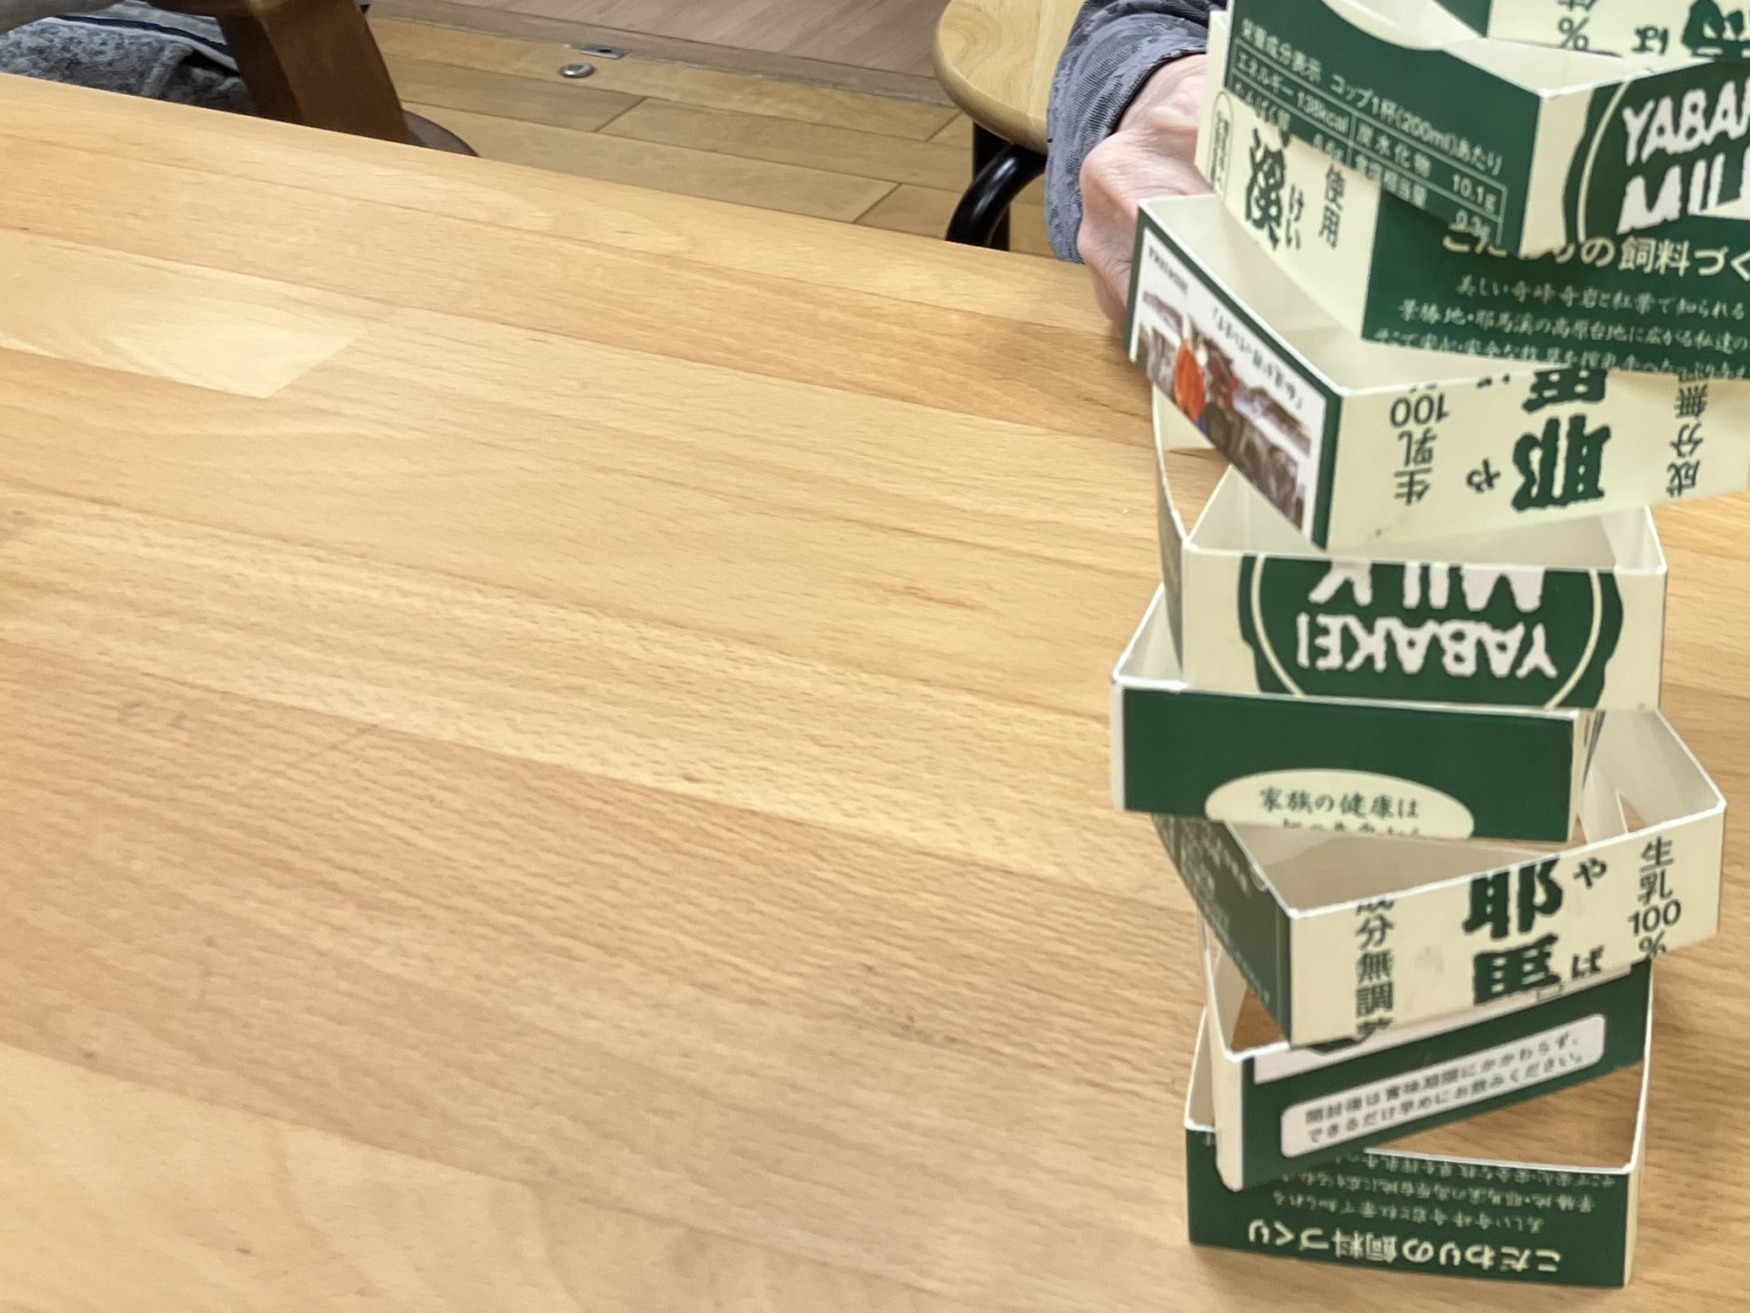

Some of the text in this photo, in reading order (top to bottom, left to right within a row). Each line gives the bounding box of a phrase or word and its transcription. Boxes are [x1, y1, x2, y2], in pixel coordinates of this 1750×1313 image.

[1390, 384, 1449, 506] 生乳100
[1666, 373, 1707, 497] 成分無
[1297, 612, 1558, 678] YABAKEI
[1248, 1219, 1560, 1273] こだわりの飼料づくり
